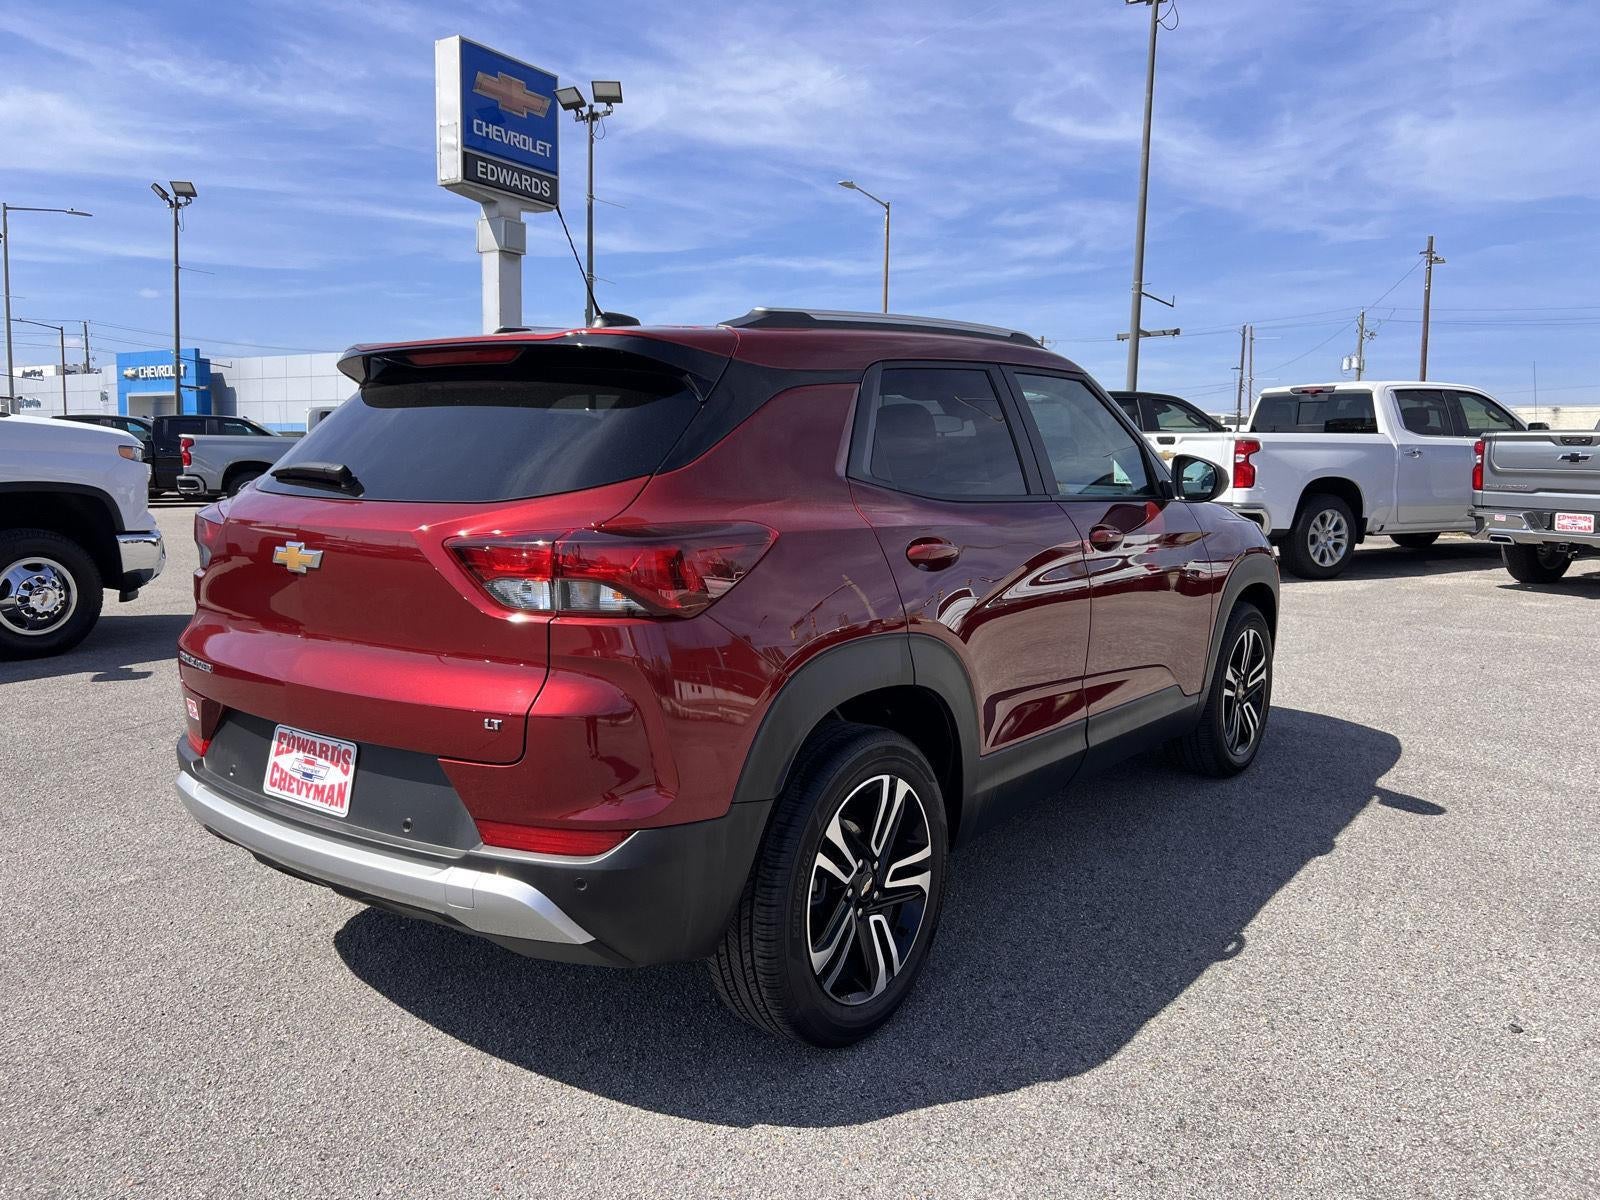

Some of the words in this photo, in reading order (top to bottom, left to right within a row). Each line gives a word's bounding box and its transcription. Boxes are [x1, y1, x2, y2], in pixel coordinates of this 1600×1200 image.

[474, 118, 552, 157] CHEVROLET
[477, 161, 551, 197] EDWARDS
[139, 364, 185, 378] CHEVROLT
[484, 718, 503, 730] LT
[274, 731, 352, 776] EDWARDS
[269, 760, 348, 809] CHEVYMAN
